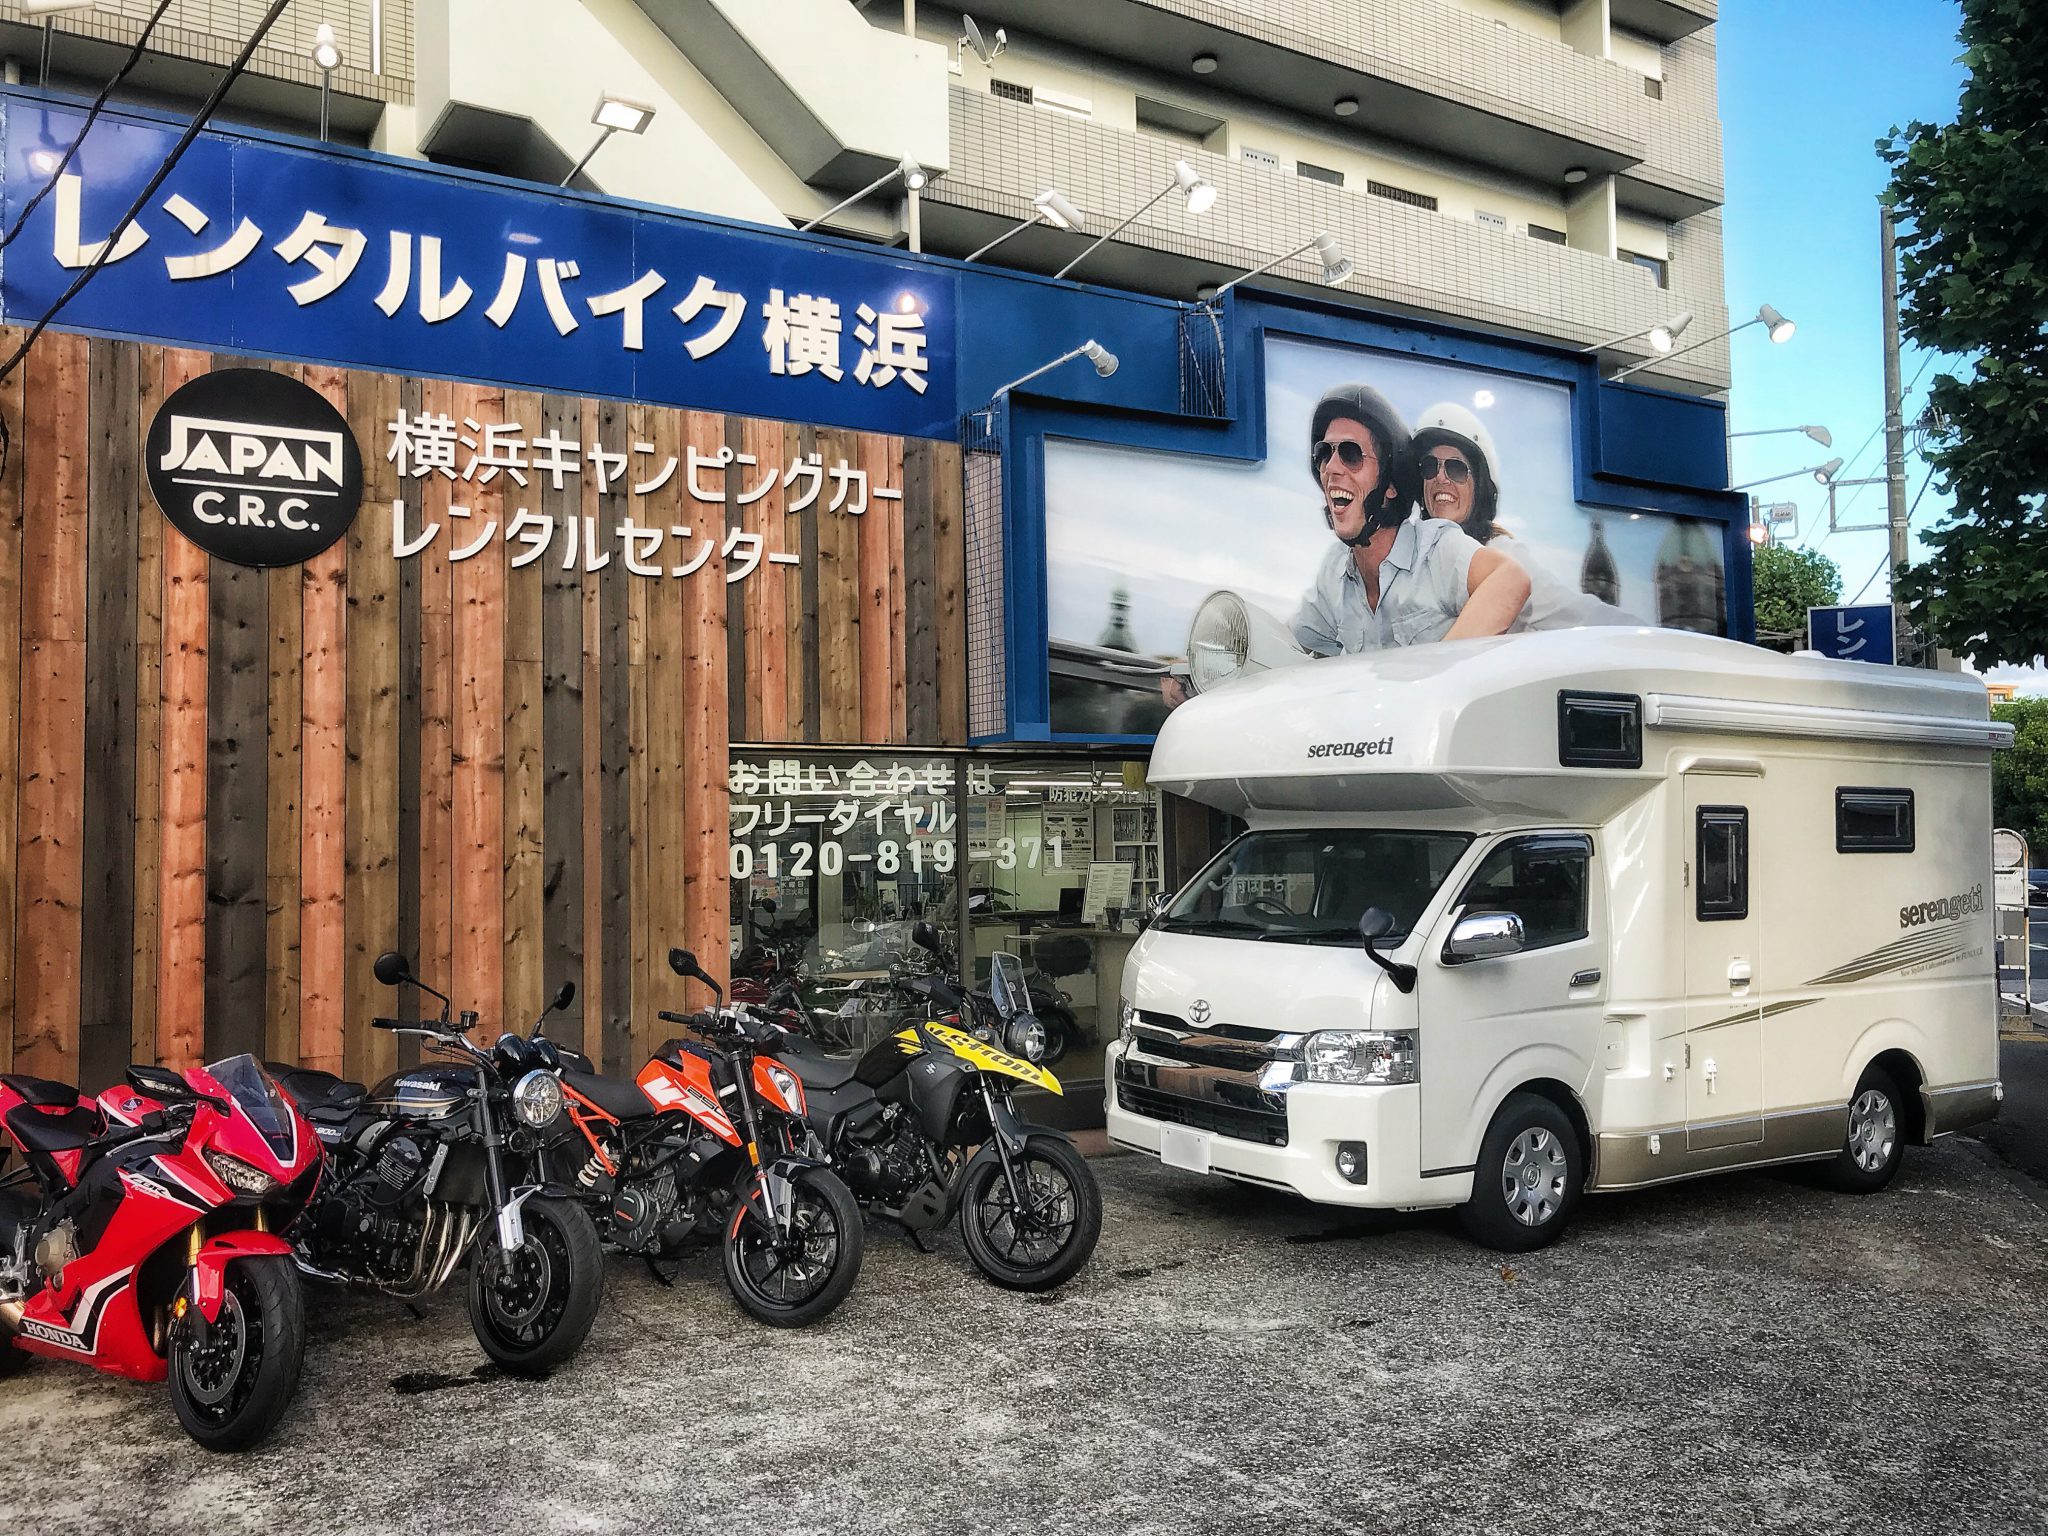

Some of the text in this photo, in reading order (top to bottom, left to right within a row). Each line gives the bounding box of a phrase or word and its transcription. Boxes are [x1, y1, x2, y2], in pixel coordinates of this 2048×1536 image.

[53, 173, 930, 394] レンタルバイク横浜
[160, 414, 344, 488] JAPAN
[386, 408, 902, 516] 横浜キャンピングカー
[192, 490, 321, 532] C.R.C.
[392, 499, 800, 583] レンタルセンター
[1836, 611, 1867, 662] レン
[1307, 736, 1394, 758] serengeti
[729, 799, 957, 837] フリーダイヤル
[1899, 883, 1984, 929] serengeti
[393, 1078, 442, 1092] Kawasaki
[23, 1320, 89, 1350] HONDA
